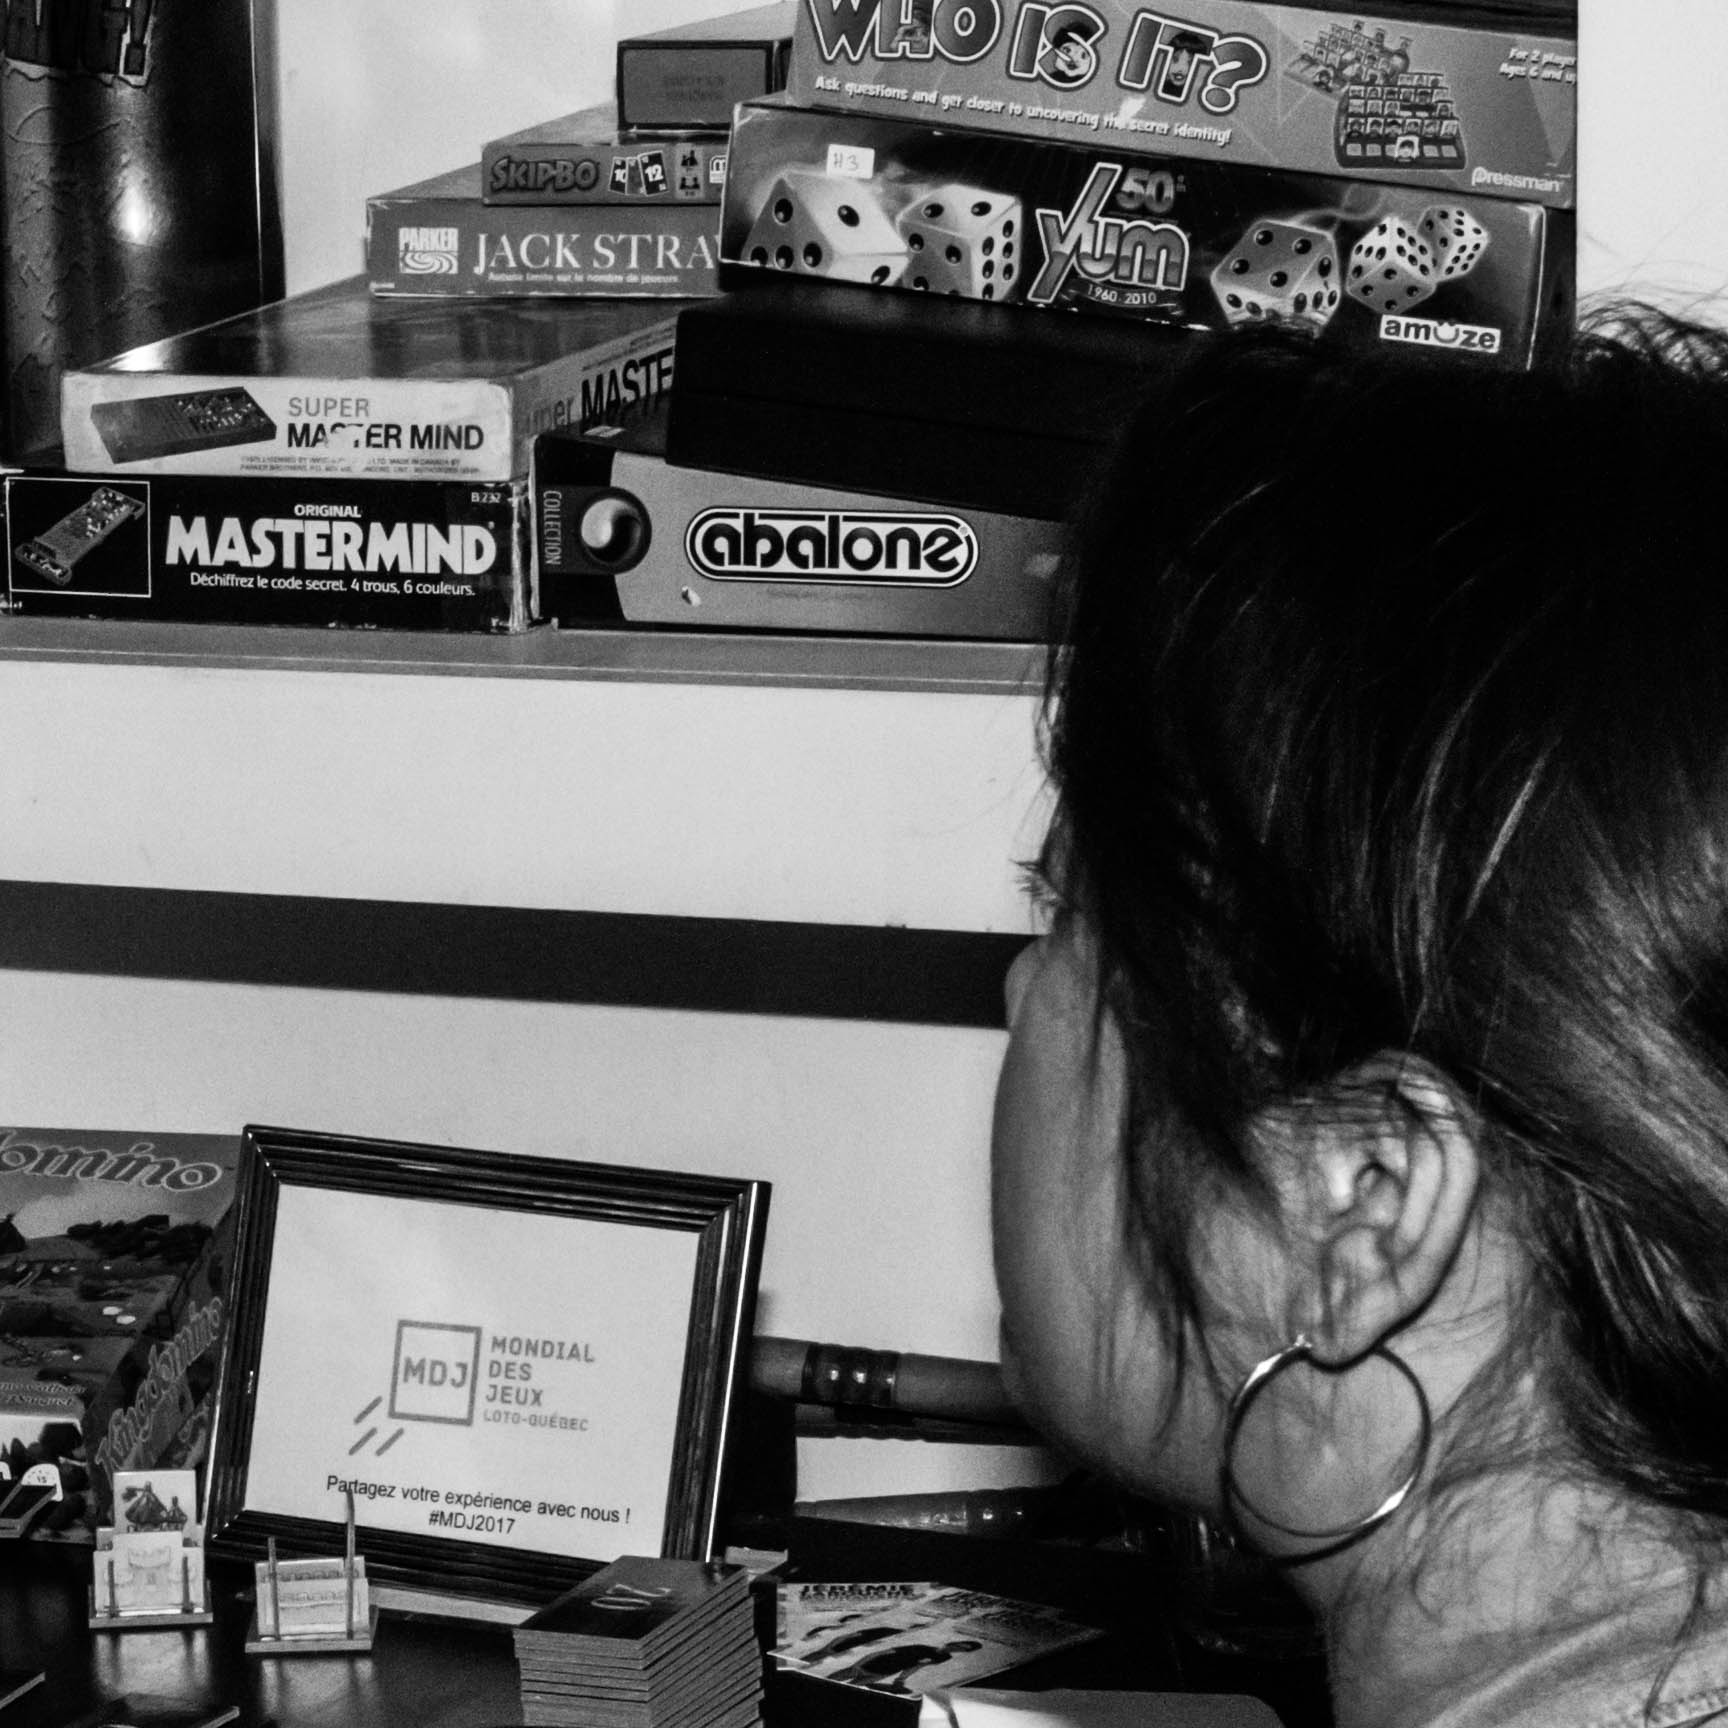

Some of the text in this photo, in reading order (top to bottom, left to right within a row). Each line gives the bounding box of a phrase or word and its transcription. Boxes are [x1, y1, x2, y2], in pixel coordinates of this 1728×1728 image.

[808, 0, 1268, 113] WHO IS IT?
[815, 75, 841, 92] Ask
[845, 79, 909, 102] questions
[912, 89, 939, 104] and
[942, 93, 964, 111] get
[966, 96, 1006, 114] closer
[1009, 102, 1022, 116] to
[1026, 106, 1099, 131] uncovering
[1128, 117, 1170, 135] secret
[1173, 120, 1231, 146] identity!
[645, 164, 664, 182] 12
[399, 228, 458, 251] PARKER
[473, 232, 721, 276] JACK STRA
[288, 397, 370, 418] SUPER
[287, 422, 484, 450] MAER MIND
[294, 504, 362, 518] ORIGINAL
[544, 490, 562, 566] COLLECTION
[165, 515, 497, 576] MASTERMIND
[701, 513, 964, 572] abalone
[190, 571, 255, 588] Déchiffrez
[257, 573, 269, 589] le
[270, 574, 303, 590] code
[350, 579, 361, 592] 4
[362, 579, 400, 595] trous,
[403, 580, 413, 594] 6
[416, 581, 476, 596] couleurs.
[490, 1335, 597, 1364] MONDIAL
[402, 1355, 469, 1390] MDJ
[488, 1360, 533, 1383] DES
[484, 1384, 545, 1408] JEUX
[482, 1409, 590, 1432] LOTO-QUÉBEC
[326, 1474, 397, 1501] Partagez
[402, 1486, 441, 1503] votre
[444, 1490, 533, 1514] expérience
[537, 1501, 577, 1519] avec
[580, 1506, 621, 1524] nous
[428, 1511, 516, 1534] #MDJ2017
